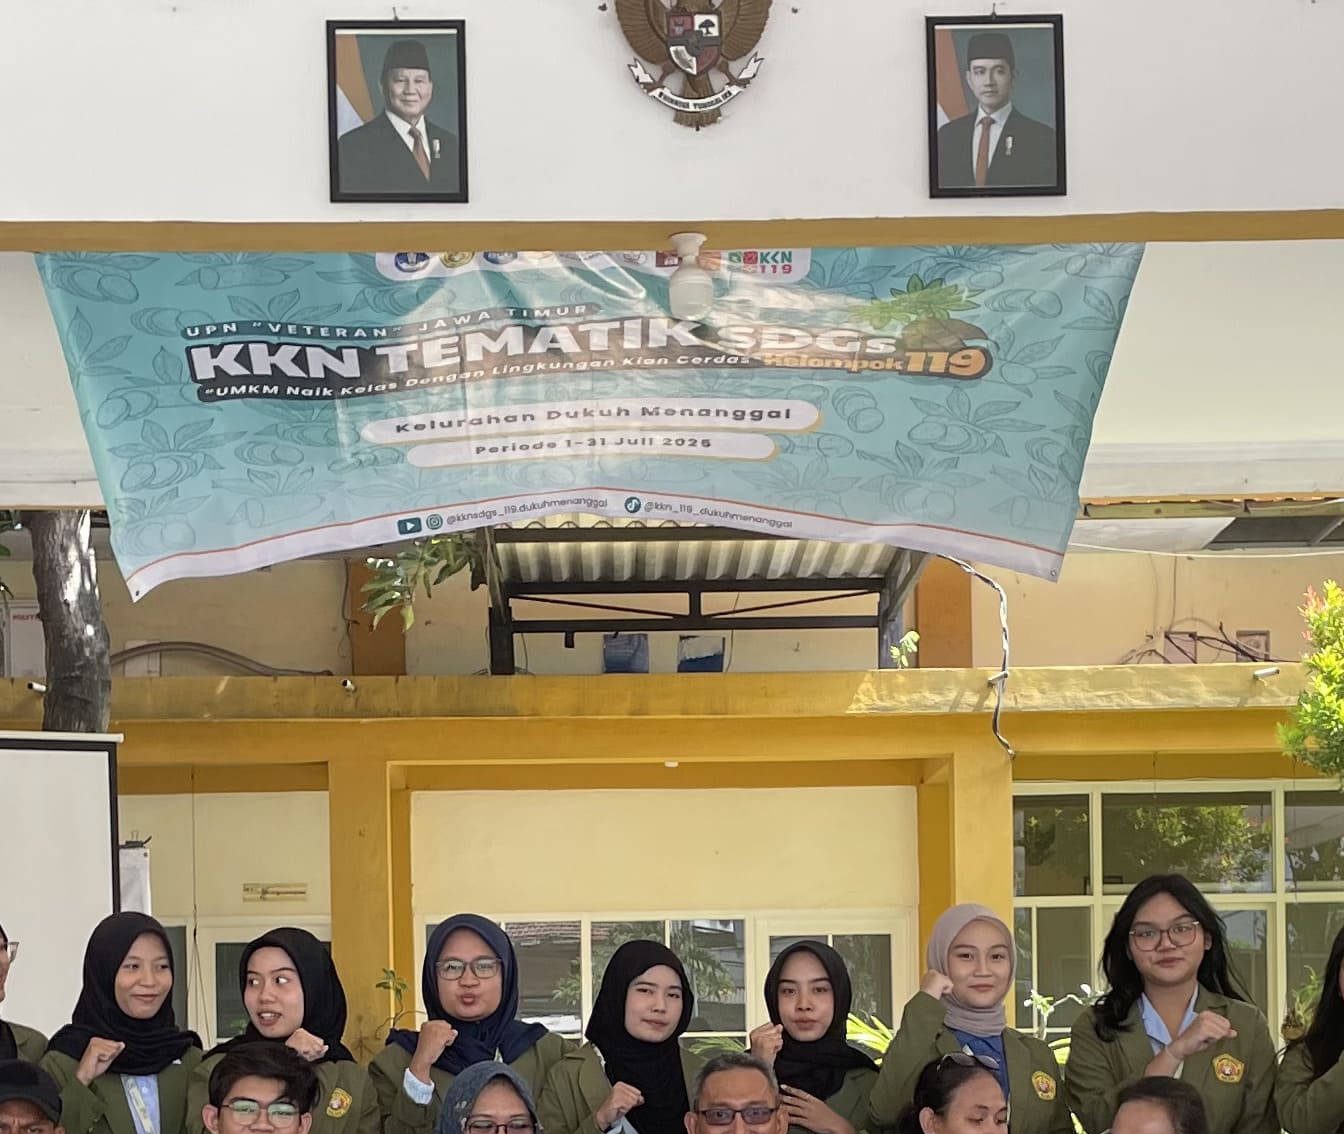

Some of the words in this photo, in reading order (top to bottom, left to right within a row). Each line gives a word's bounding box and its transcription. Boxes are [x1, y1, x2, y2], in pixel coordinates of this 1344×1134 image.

[760, 264, 793, 274] 119
[186, 322, 237, 337] UPN
[419, 310, 491, 331] JAWA
[506, 304, 587, 318] TIMUR
[190, 342, 361, 380] KKN
[375, 317, 705, 374] TEMATIK
[716, 325, 897, 353] SDGs
[286, 385, 333, 397] Naik
[341, 380, 398, 395] Kelas
[405, 368, 485, 387] Dengan
[492, 357, 615, 375] Lingkungan
[621, 355, 669, 366] Kian
[763, 353, 903, 372] Kelompok
[905, 349, 986, 377] 119
[395, 412, 536, 433] Kelurahan
[546, 407, 631, 420] Dukuh
[641, 406, 791, 421] Menanggal
[475, 441, 557, 454] Periode
[614, 437, 654, 446] Juli
